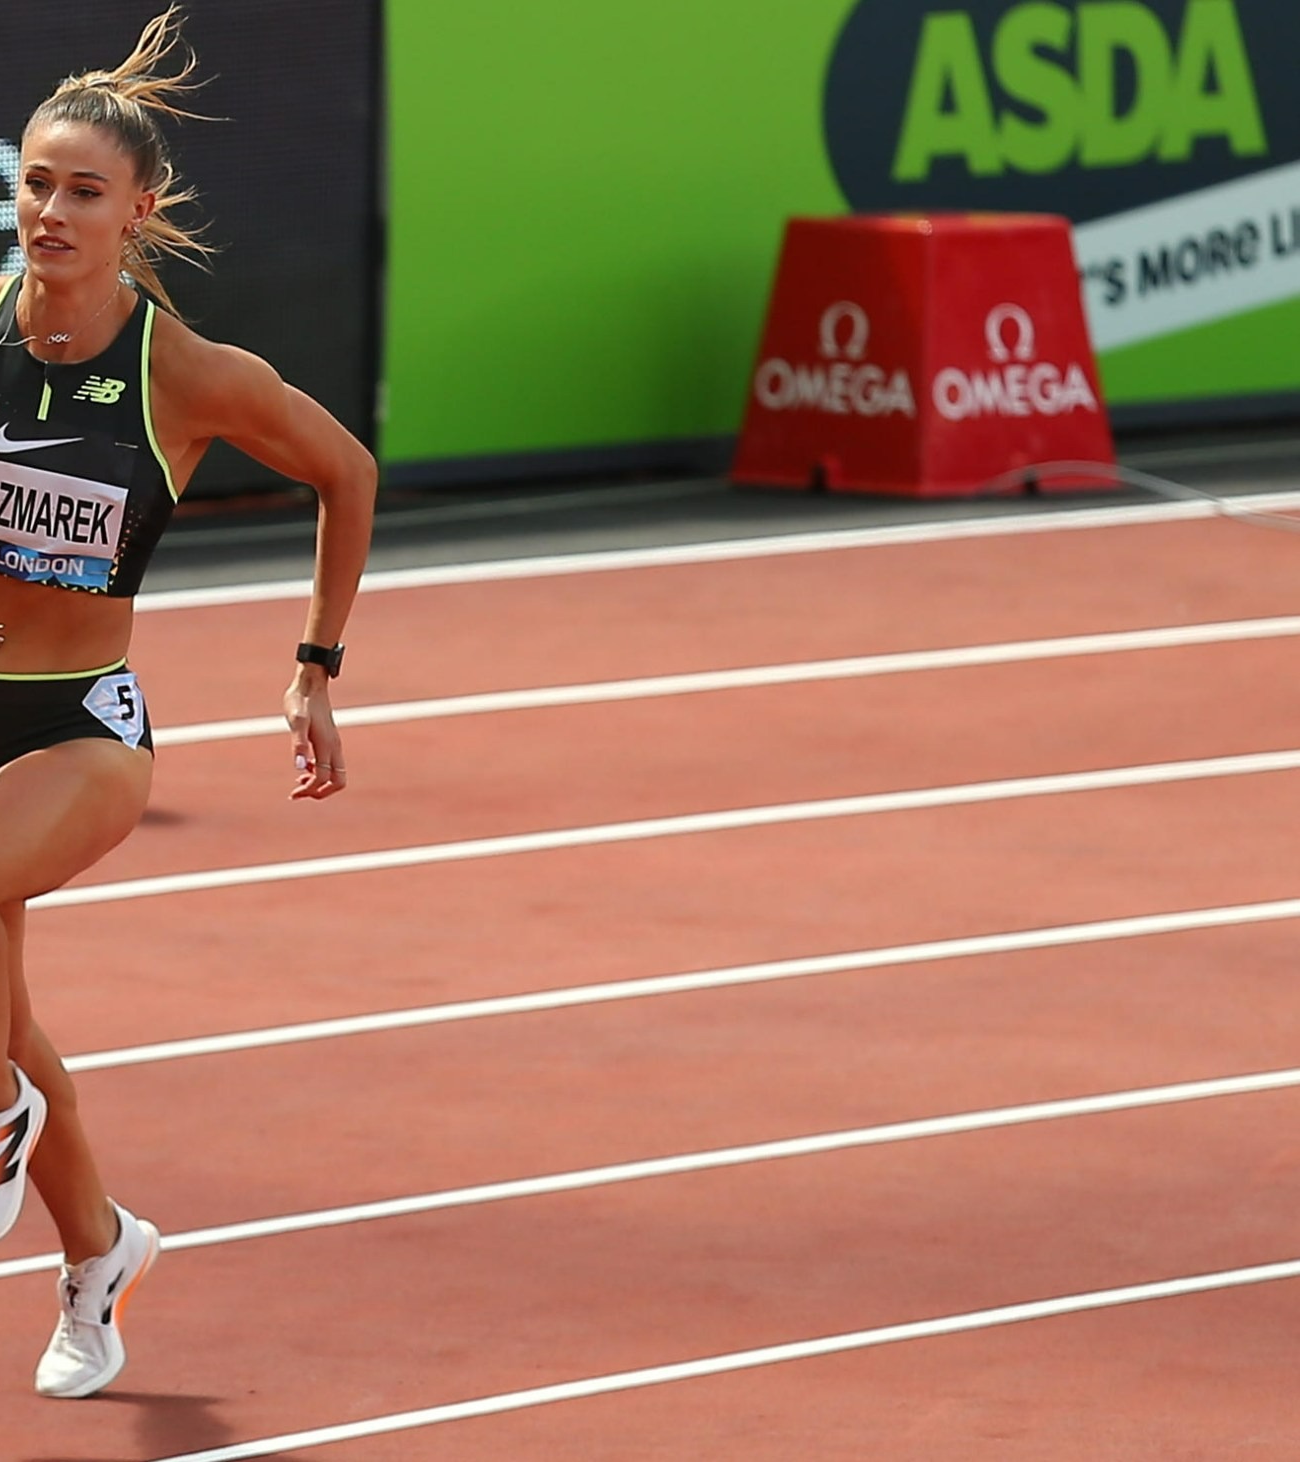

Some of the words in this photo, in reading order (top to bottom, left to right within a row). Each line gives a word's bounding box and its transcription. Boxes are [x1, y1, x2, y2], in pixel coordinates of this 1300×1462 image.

[891, 0, 1268, 181] ASDA
[1078, 253, 1127, 308] 'S
[754, 357, 917, 419] OMEGA
[932, 361, 1098, 421] OMEGA
[117, 685, 135, 720] 5
